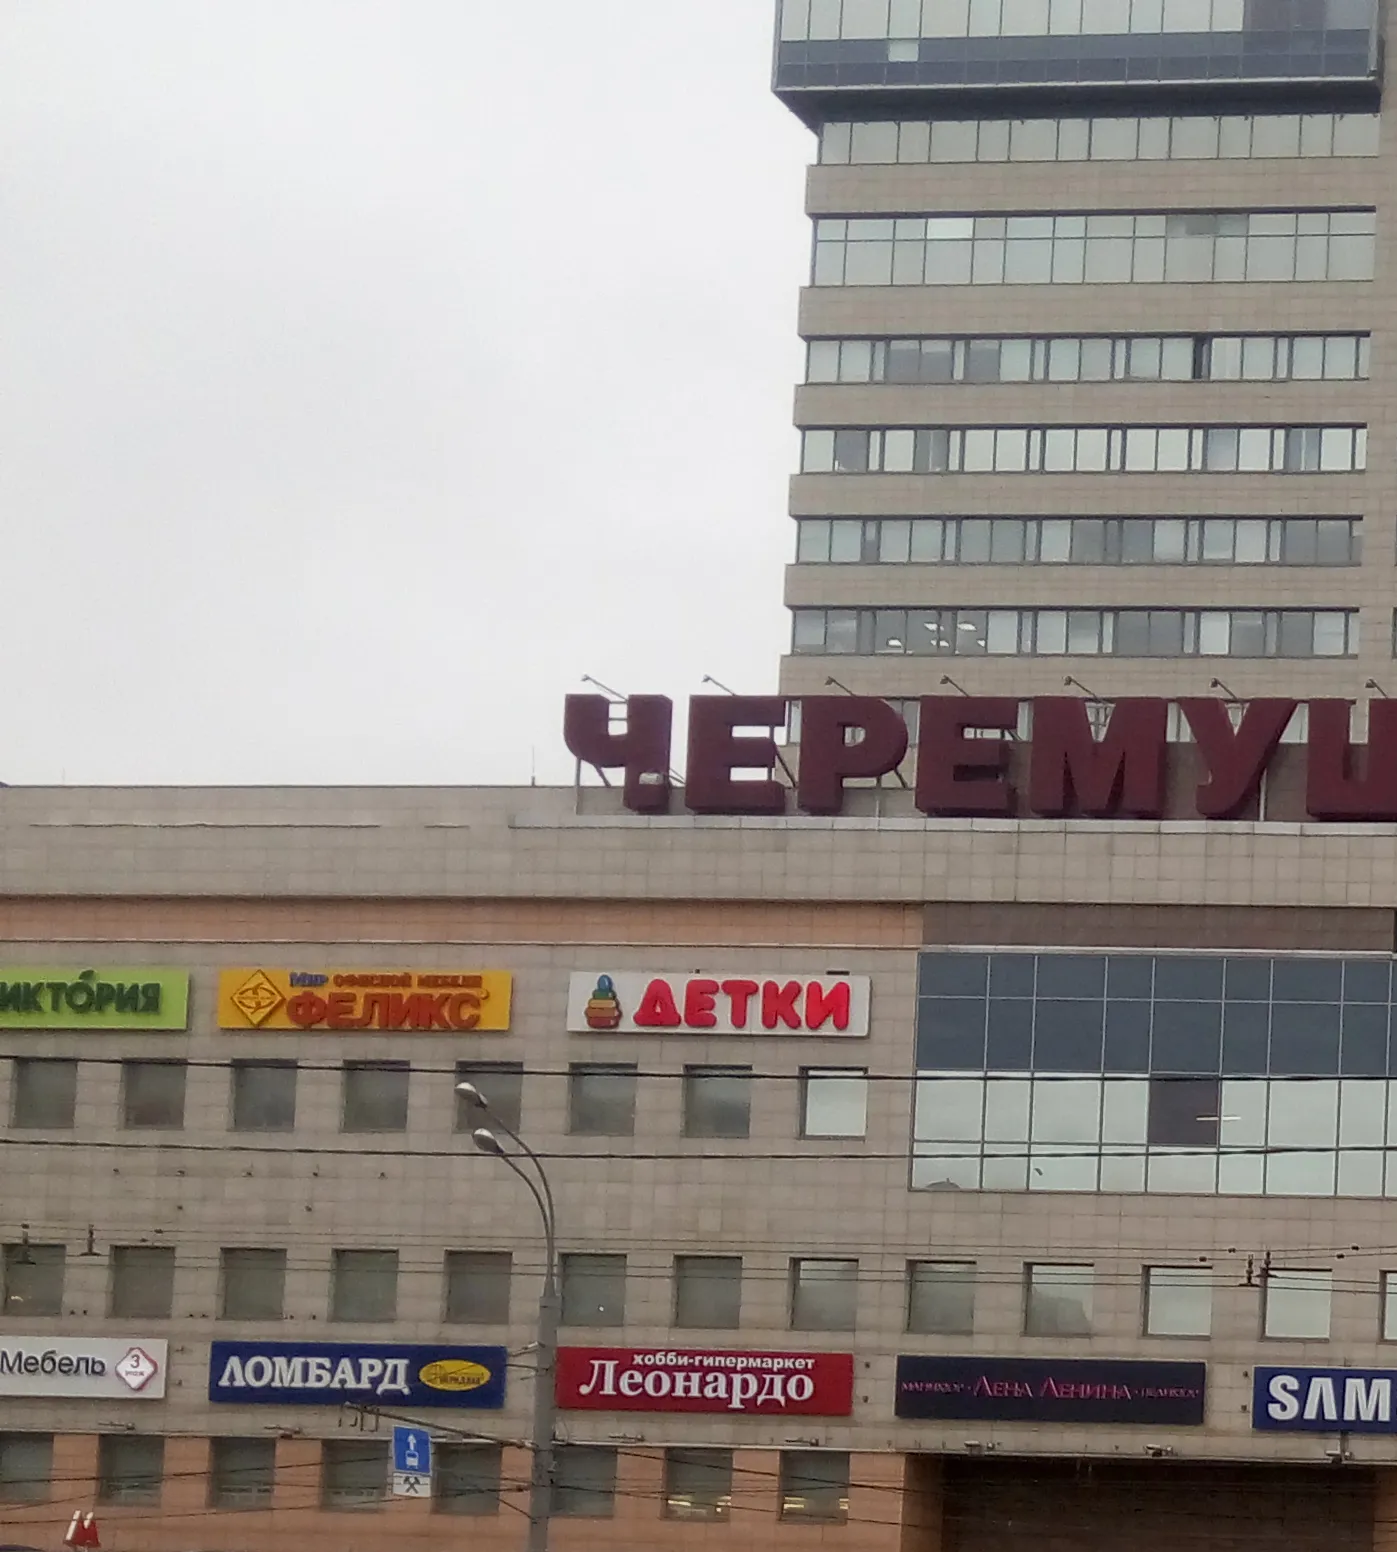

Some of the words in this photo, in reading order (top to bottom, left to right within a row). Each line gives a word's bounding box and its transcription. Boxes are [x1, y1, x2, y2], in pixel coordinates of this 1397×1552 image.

[0, 980, 162, 1014] ИКТОРИЯ
[286, 991, 482, 1030] ФЕЛИКС
[633, 977, 851, 1031] ДЕТКИ
[0, 1350, 106, 1377] Мебель
[130, 1353, 140, 1369] 3
[218, 1355, 412, 1395] ЛОМБАРД
[632, 1351, 816, 1370] хобби-гипермаркет
[578, 1359, 815, 1409] Леонардо
